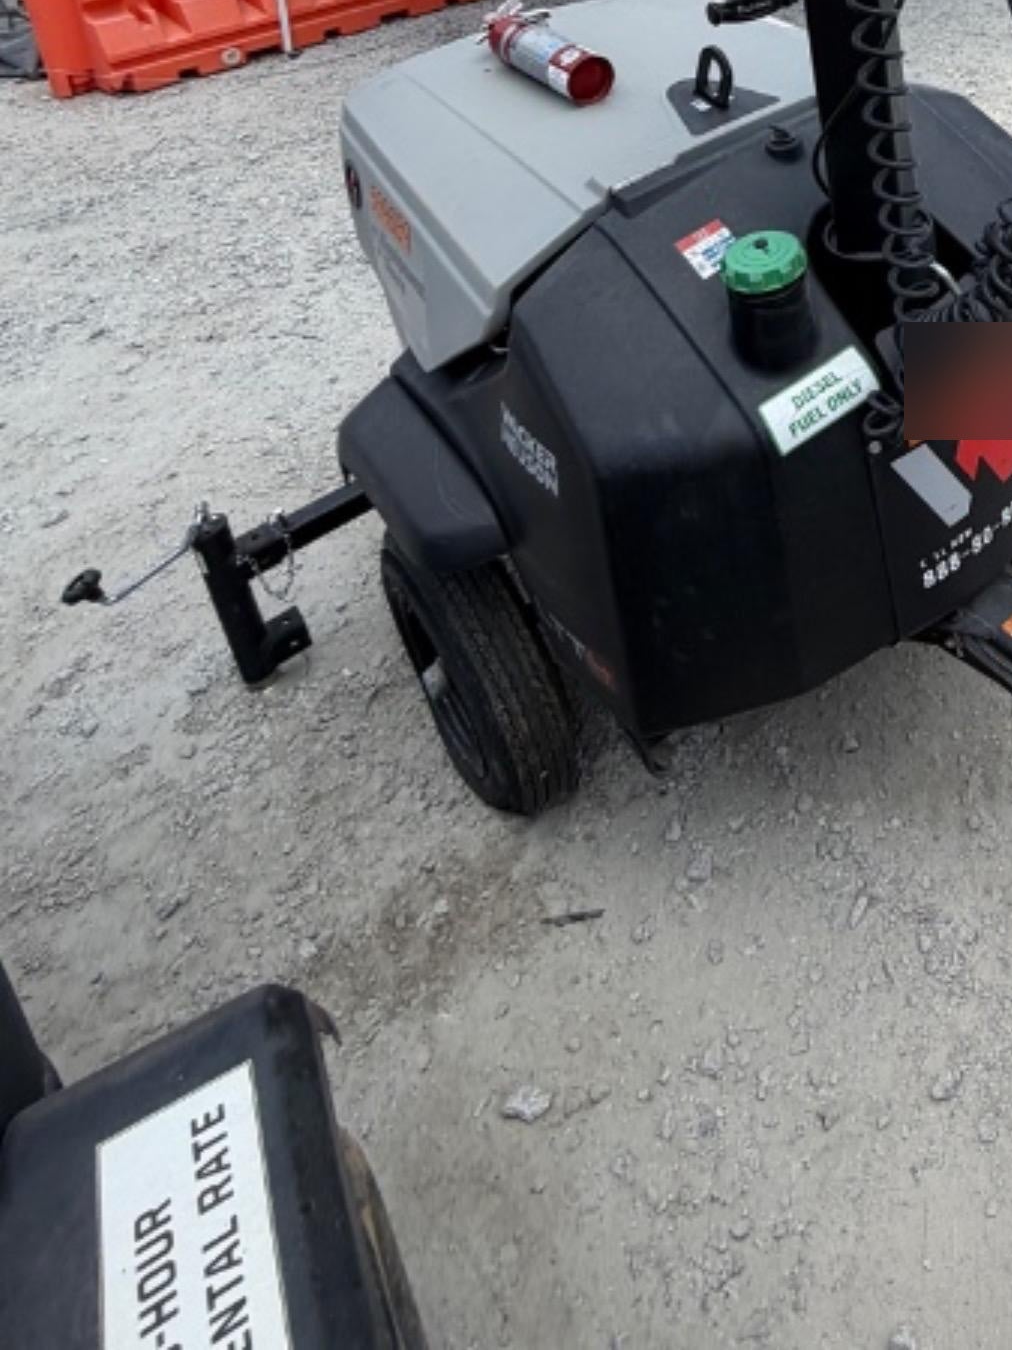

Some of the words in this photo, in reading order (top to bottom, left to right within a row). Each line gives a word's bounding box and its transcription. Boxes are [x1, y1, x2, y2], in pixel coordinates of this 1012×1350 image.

[787, 406, 828, 438] FUEL
[826, 377, 862, 413] ONLY
[790, 371, 843, 410] DIESEL
[190, 1102, 235, 1216] RATE
[133, 1196, 182, 1350] -HOUR
